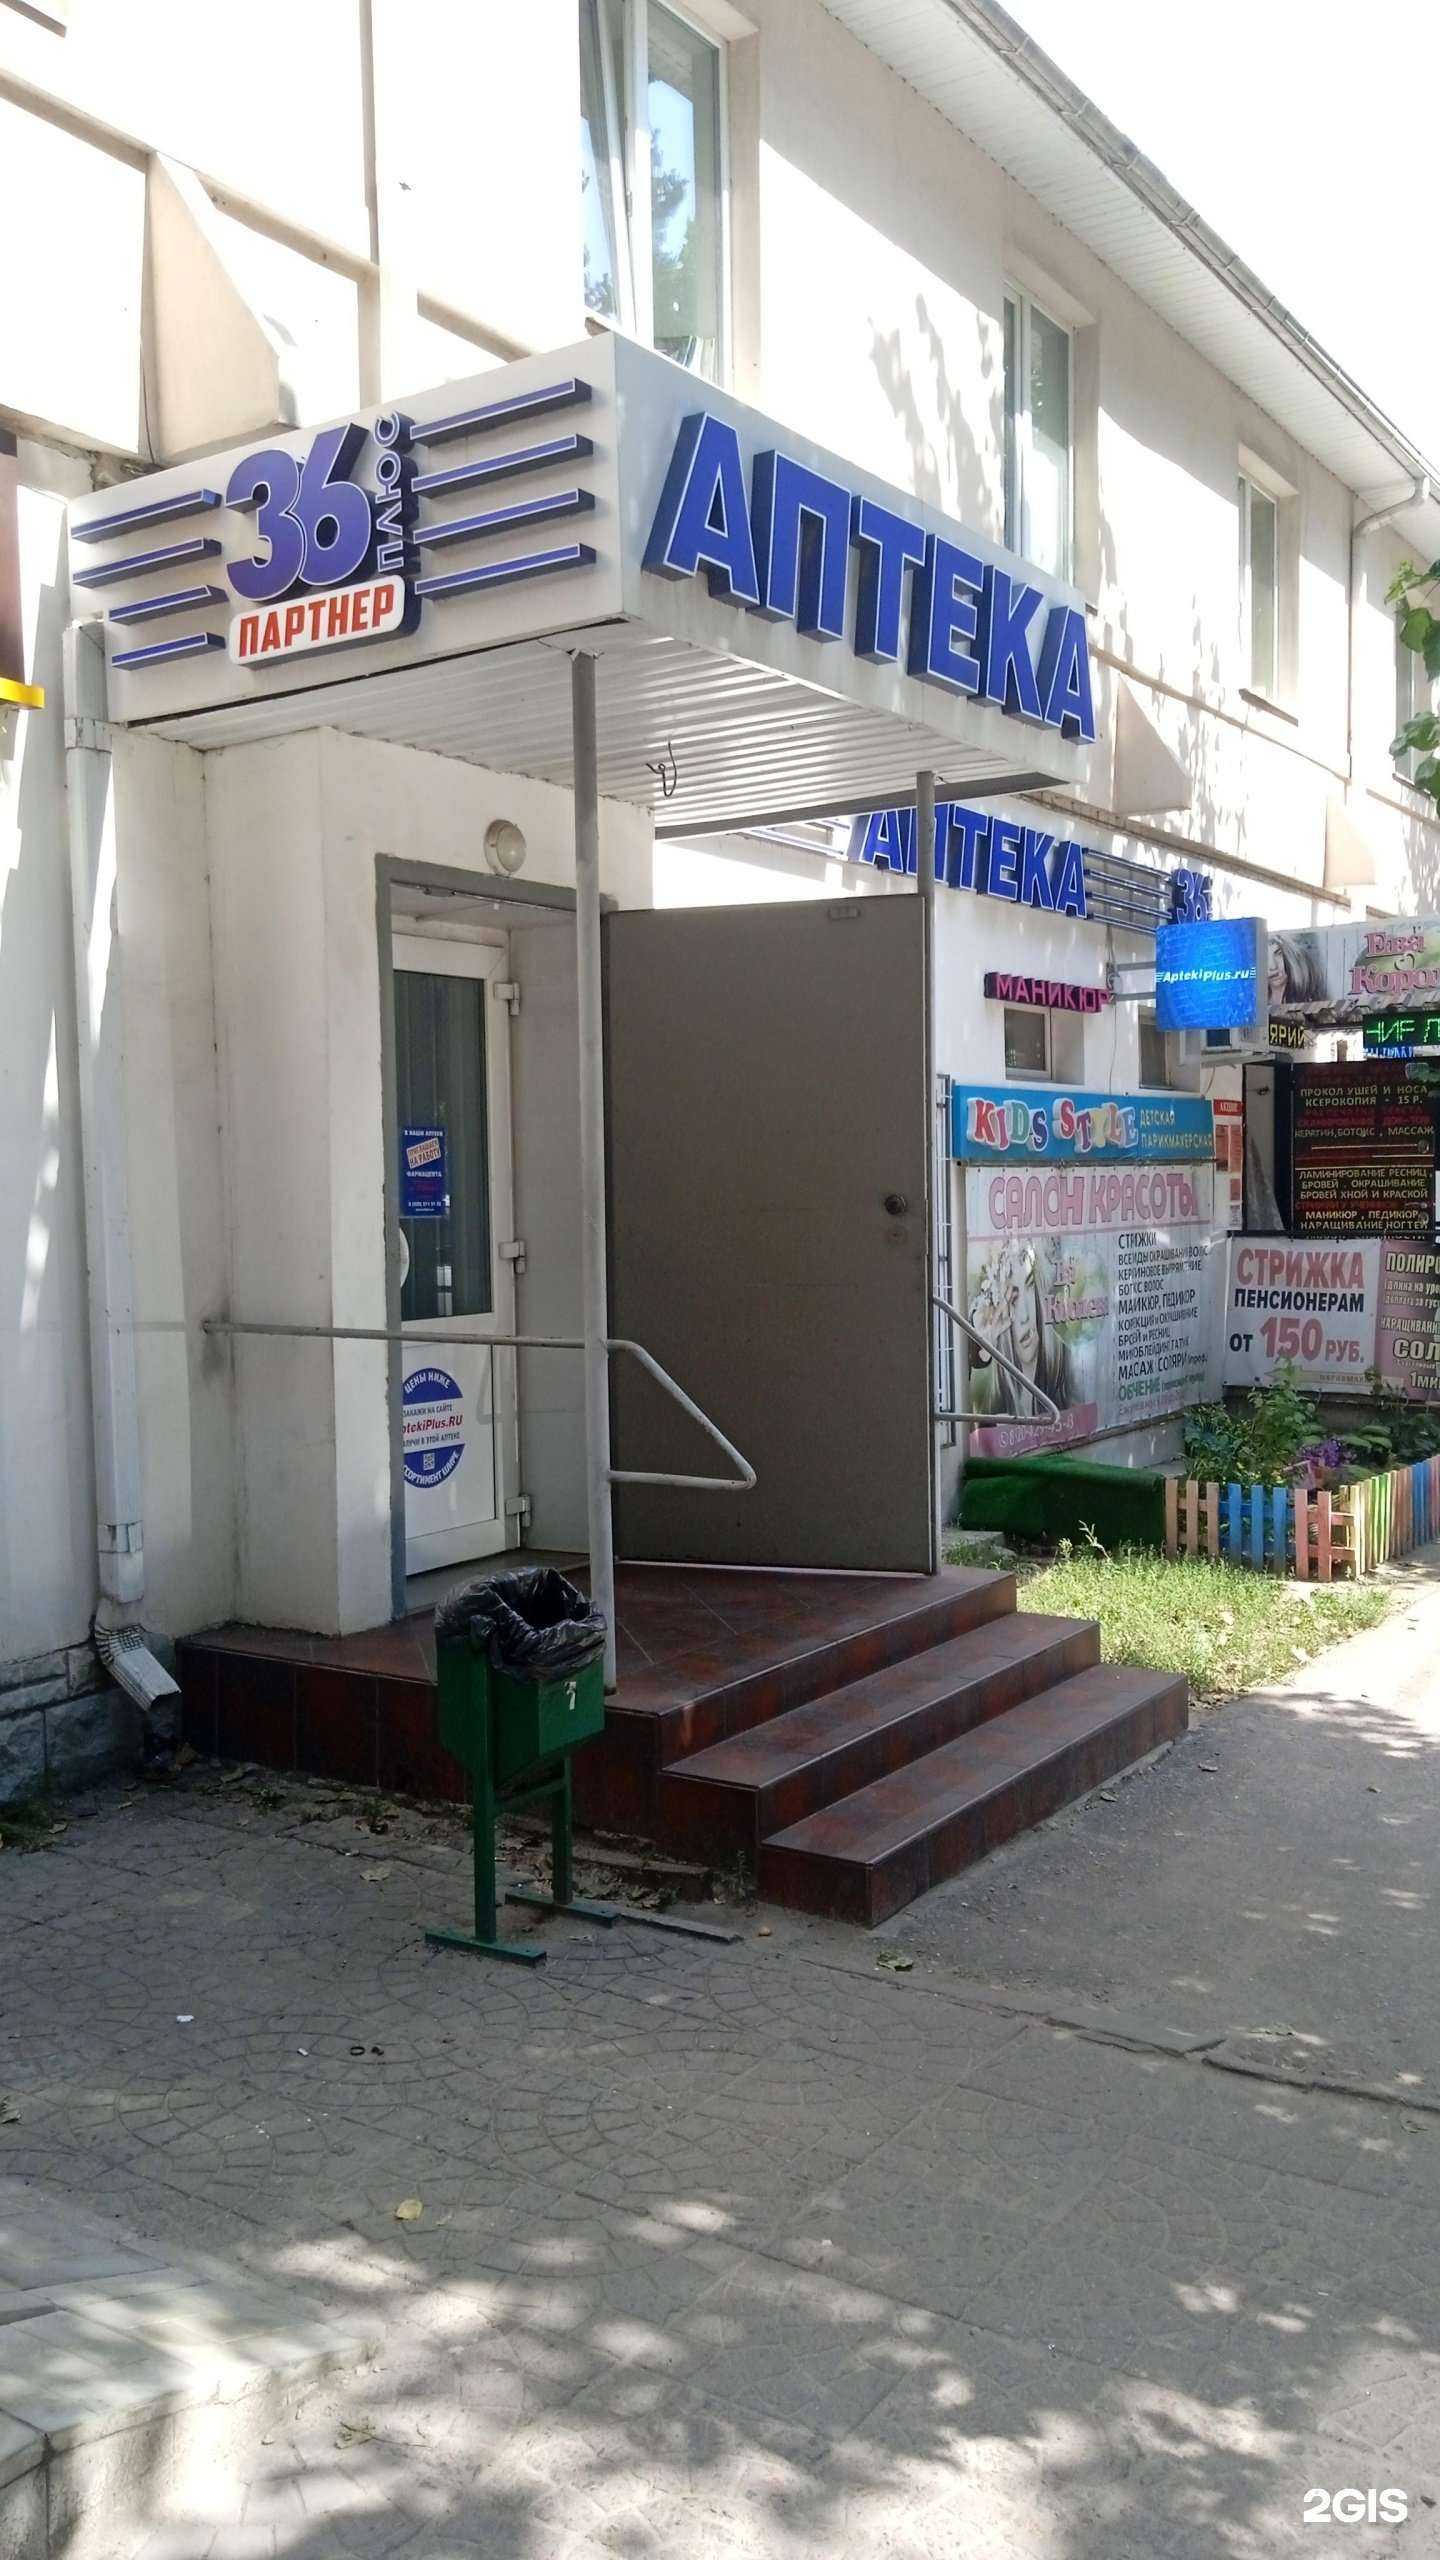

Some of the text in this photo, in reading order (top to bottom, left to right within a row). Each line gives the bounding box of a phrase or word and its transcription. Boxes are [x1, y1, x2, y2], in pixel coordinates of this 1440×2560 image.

[374, 410, 405, 573] ПЛЮС
[226, 422, 371, 601] 36
[645, 411, 1097, 744] АПТЕКА
[238, 584, 395, 658] ПАРТНЕР
[1162, 969, 1250, 983] AptekiPlus.ru
[996, 973, 1113, 1013] МАНИКЮР
[1301, 1087, 1343, 1097] ПРОКОЛ
[1347, 1085, 1378, 1095] УШЕЙ
[1383, 1086, 1391, 1095] И
[1305, 1097, 1377, 1107] КСЕРОКОПИЯ
[969, 1097, 1140, 1152] KIDS STYLE
[1140, 1109, 1175, 1125] ДЕТСКАЯ
[1141, 1133, 1213, 1148] ПАРИКМАХЕРСКАЯ
[1387, 1126, 1434, 1136] МАССАЖ
[1299, 1168, 1386, 1179] ЛАМИНИРОВАНИЕ
[1301, 1178, 1426, 1189] БРОВЕЙ ОКРАШИВАНИЕ
[988, 1175, 1084, 1230] САЛОН
[1088, 1173, 1199, 1224] КРАСОТЫ
[1300, 1188, 1429, 1200] БРОВЕЙ ХНОЙ И КРАСКОЙ
[1305, 1210, 1358, 1220] МАНИКЮР
[1300, 1221, 1383, 1230] НАРАЩИВАНИЕ
[1237, 1248, 1365, 1289] СТРИЖКА
[1234, 1288, 1364, 1313] ПЕНСИОНЕРАМ
[1229, 1315, 1365, 1364] ОТ 150 РУБ.
[404, 1371, 451, 1394] ЦЕНЫ НИЖЕ
